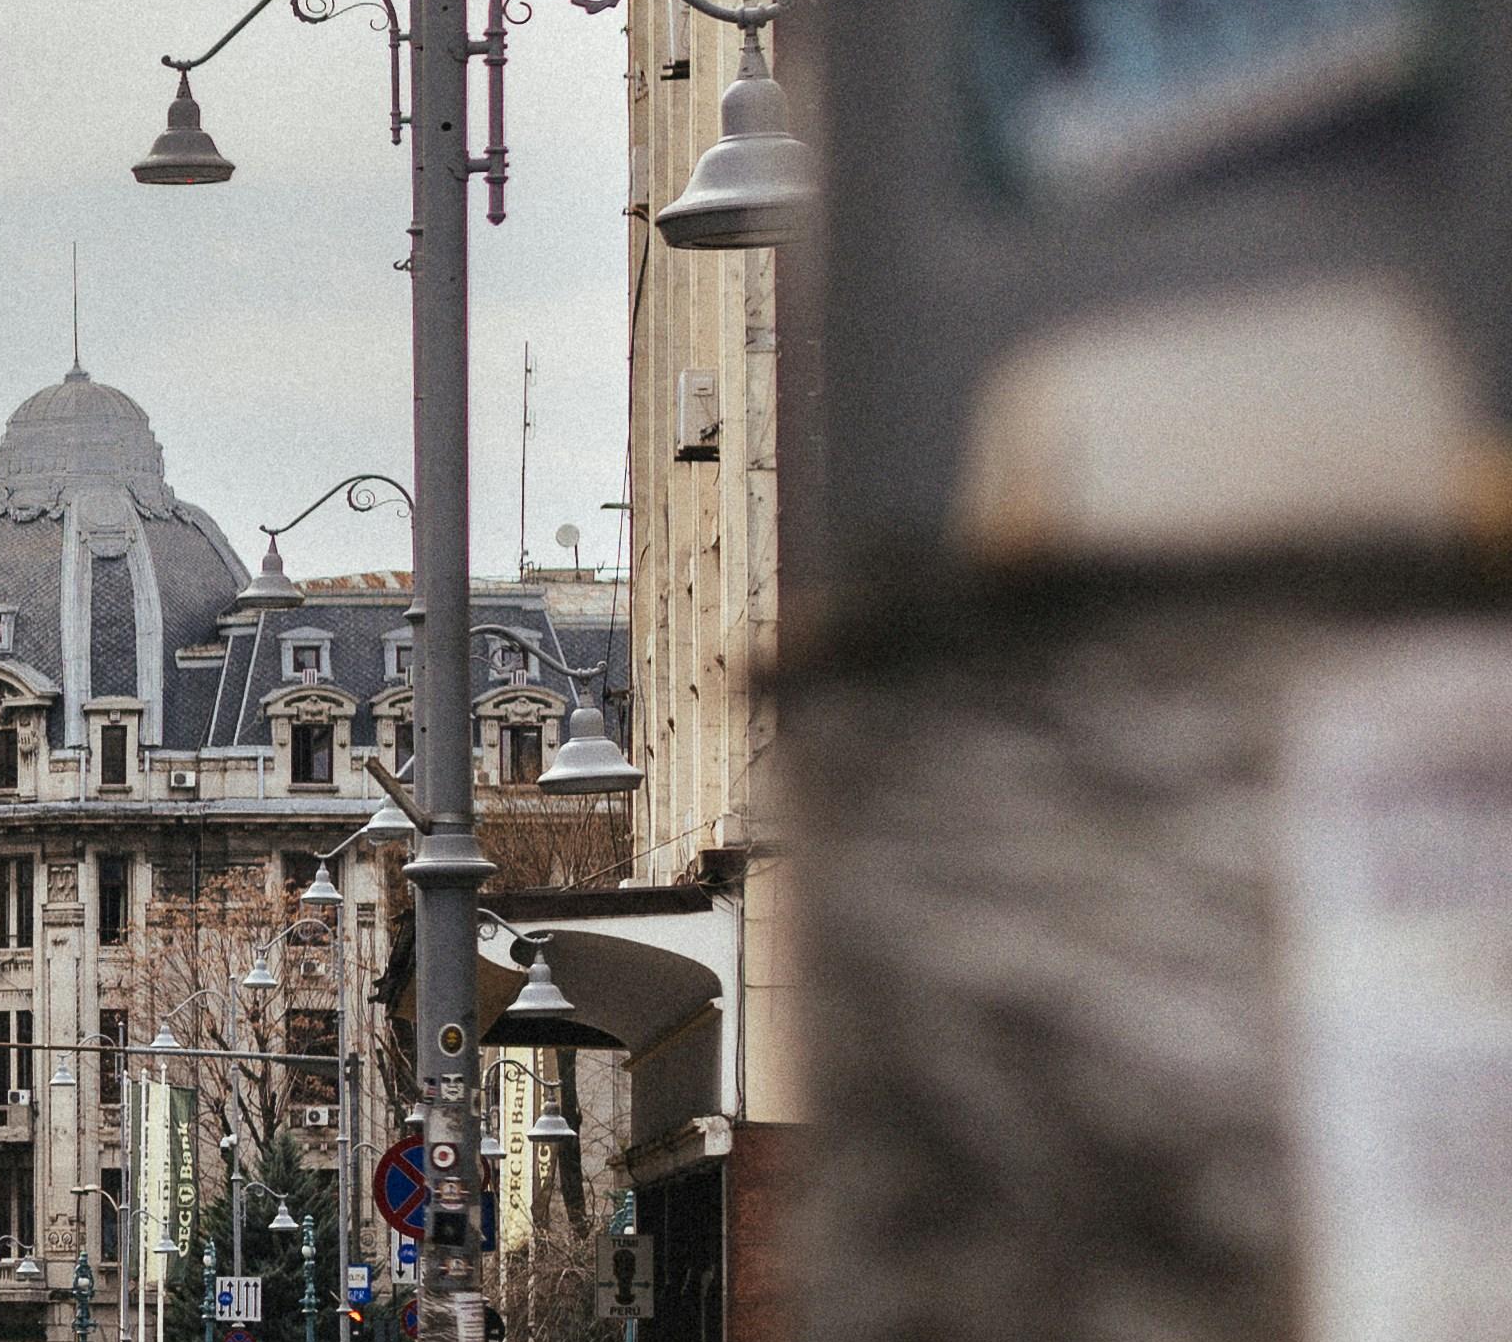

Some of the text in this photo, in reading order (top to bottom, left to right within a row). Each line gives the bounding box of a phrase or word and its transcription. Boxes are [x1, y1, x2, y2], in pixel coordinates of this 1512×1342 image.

[177, 1121, 193, 1258] CEC Bank
[510, 1159, 523, 1210] CEC
[611, 1238, 639, 1248] TUMI
